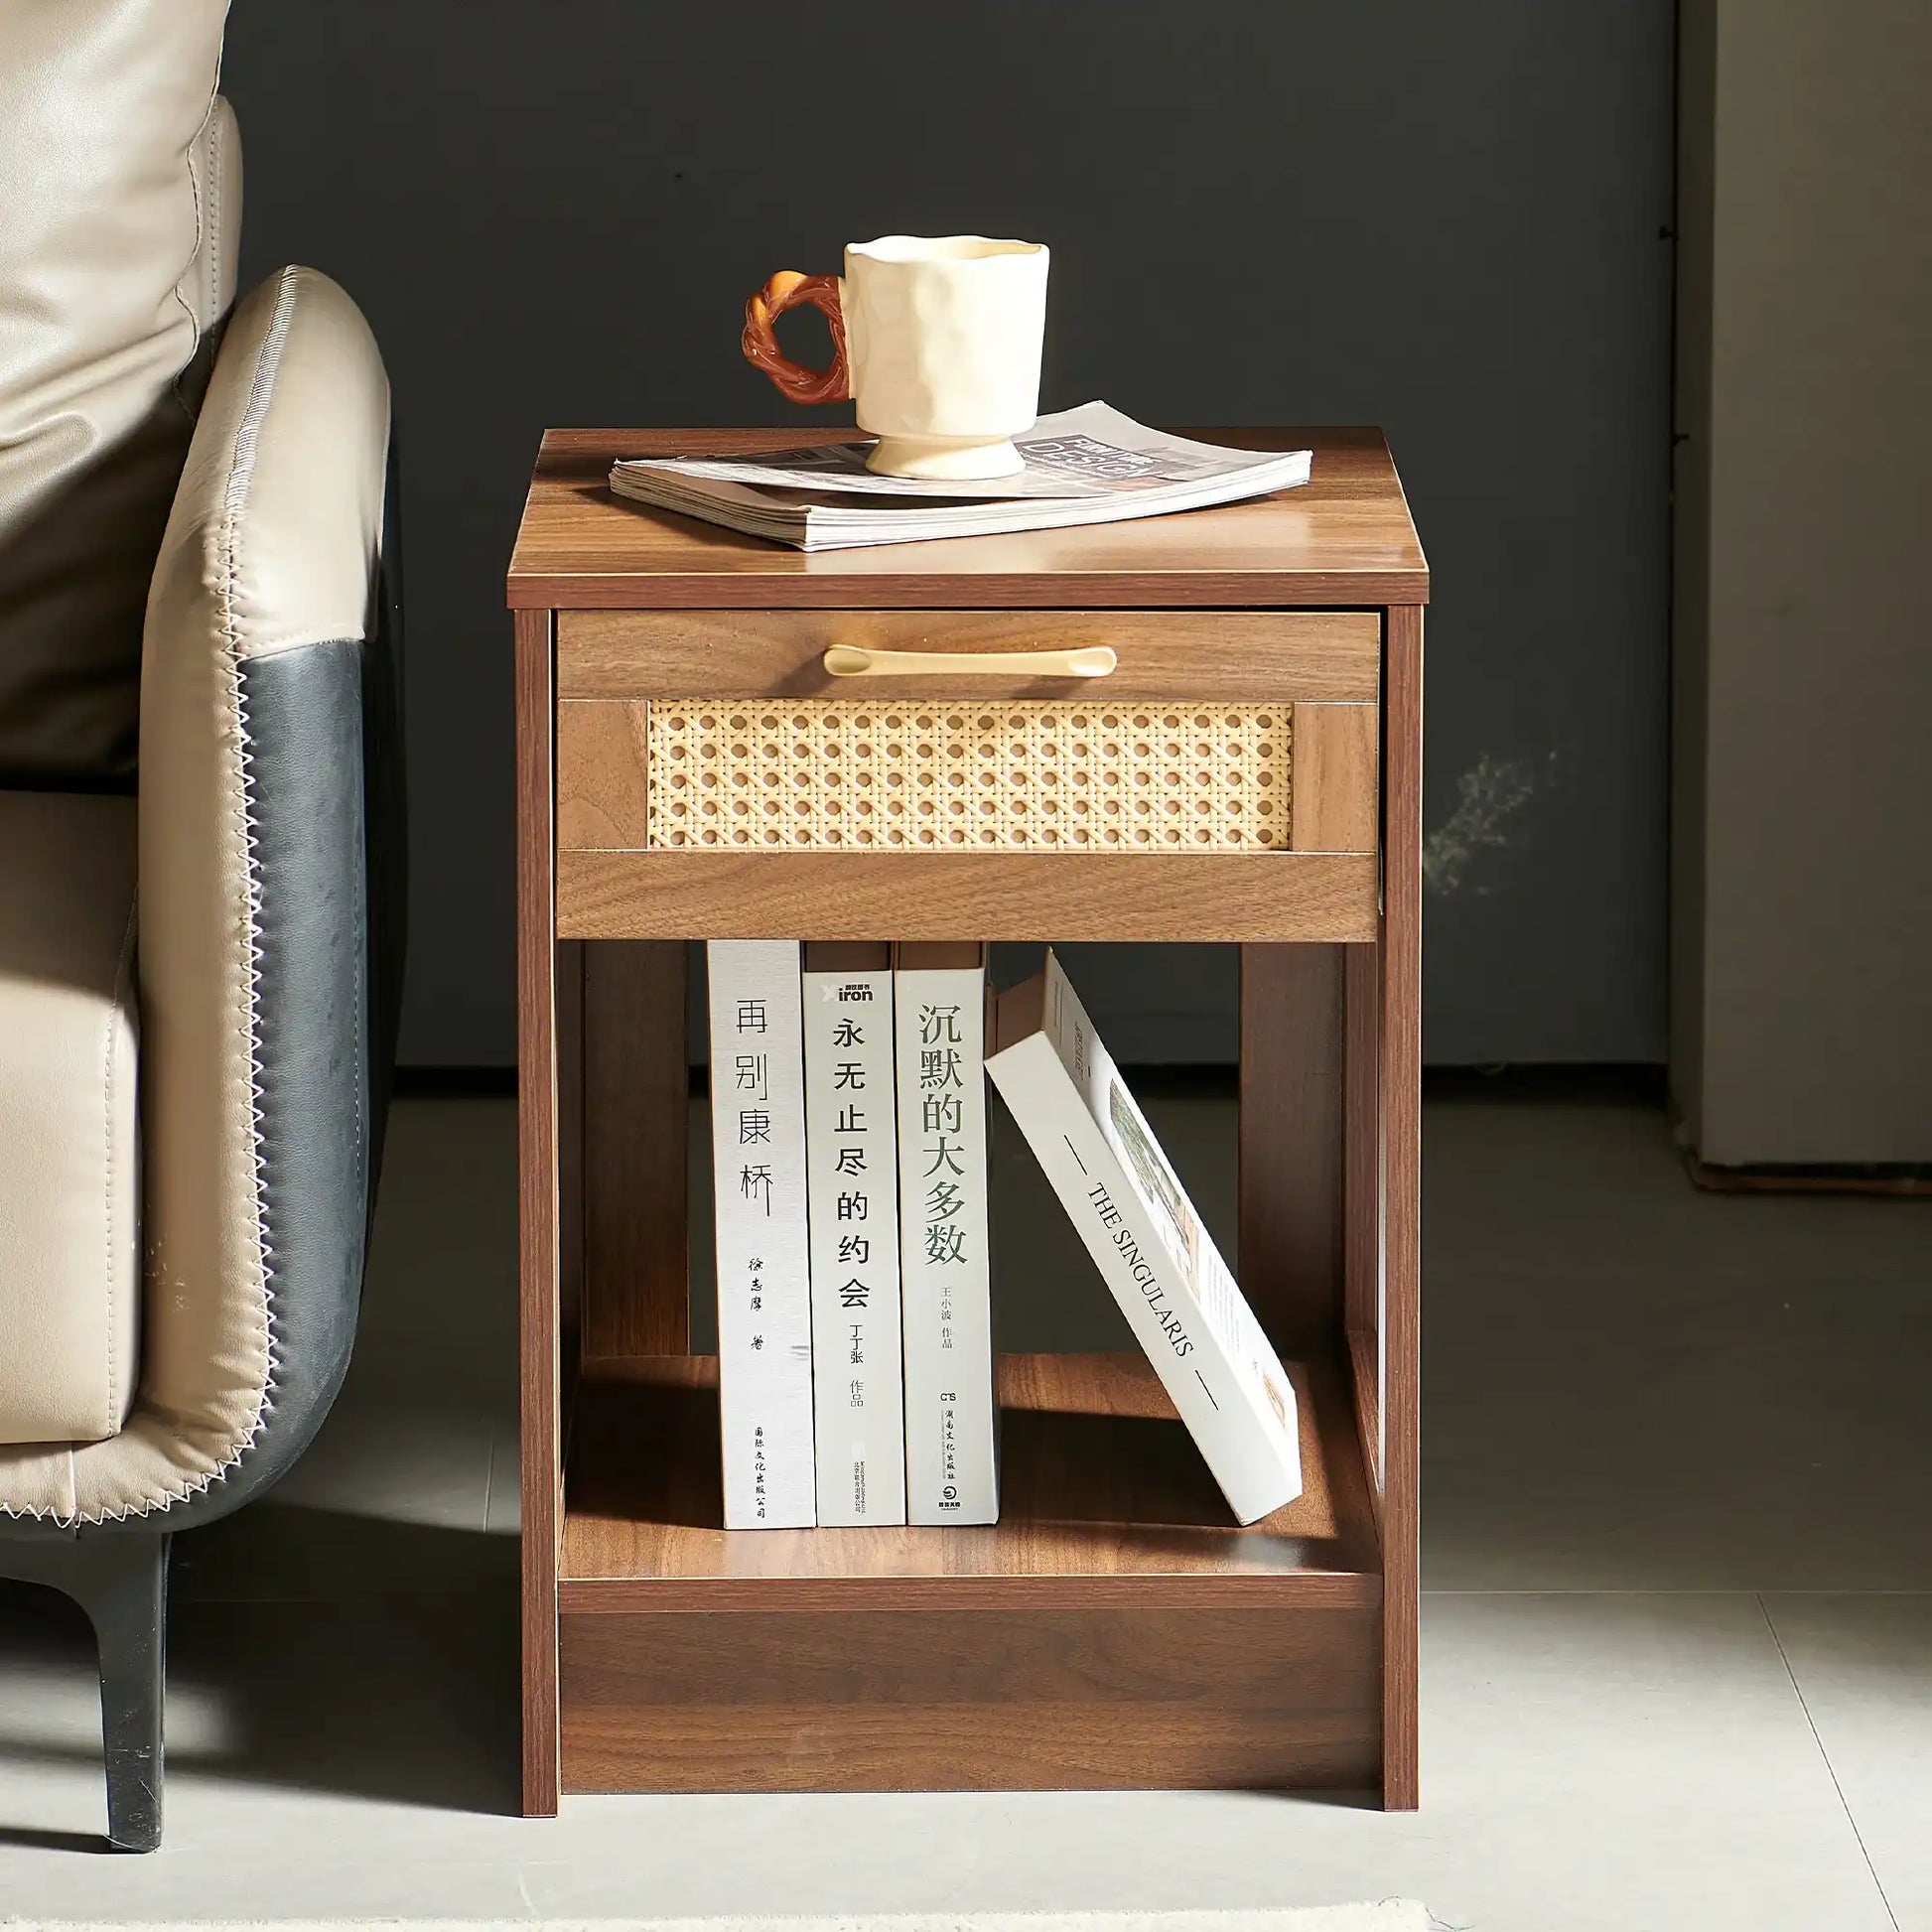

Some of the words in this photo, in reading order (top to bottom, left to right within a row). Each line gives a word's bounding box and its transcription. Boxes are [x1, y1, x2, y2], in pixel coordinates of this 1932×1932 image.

[1022, 442, 1164, 478] DESIGN
[735, 999, 773, 1217] 再别康桥
[918, 1004, 968, 1266] 沉默的大多数
[832, 1018, 871, 1309] 永无止尽的约会
[747, 1256, 764, 1311] 徐志摩
[1088, 1181, 1123, 1230] THE
[1112, 1229, 1194, 1357] SINGULARIS
[940, 1286, 952, 1321] 王小波
[849, 1323, 865, 1365] 丁丁张
[941, 1326, 953, 1349] 作品
[849, 1379, 865, 1408] 作品
[754, 1426, 766, 1519] 国际文化出版公司
